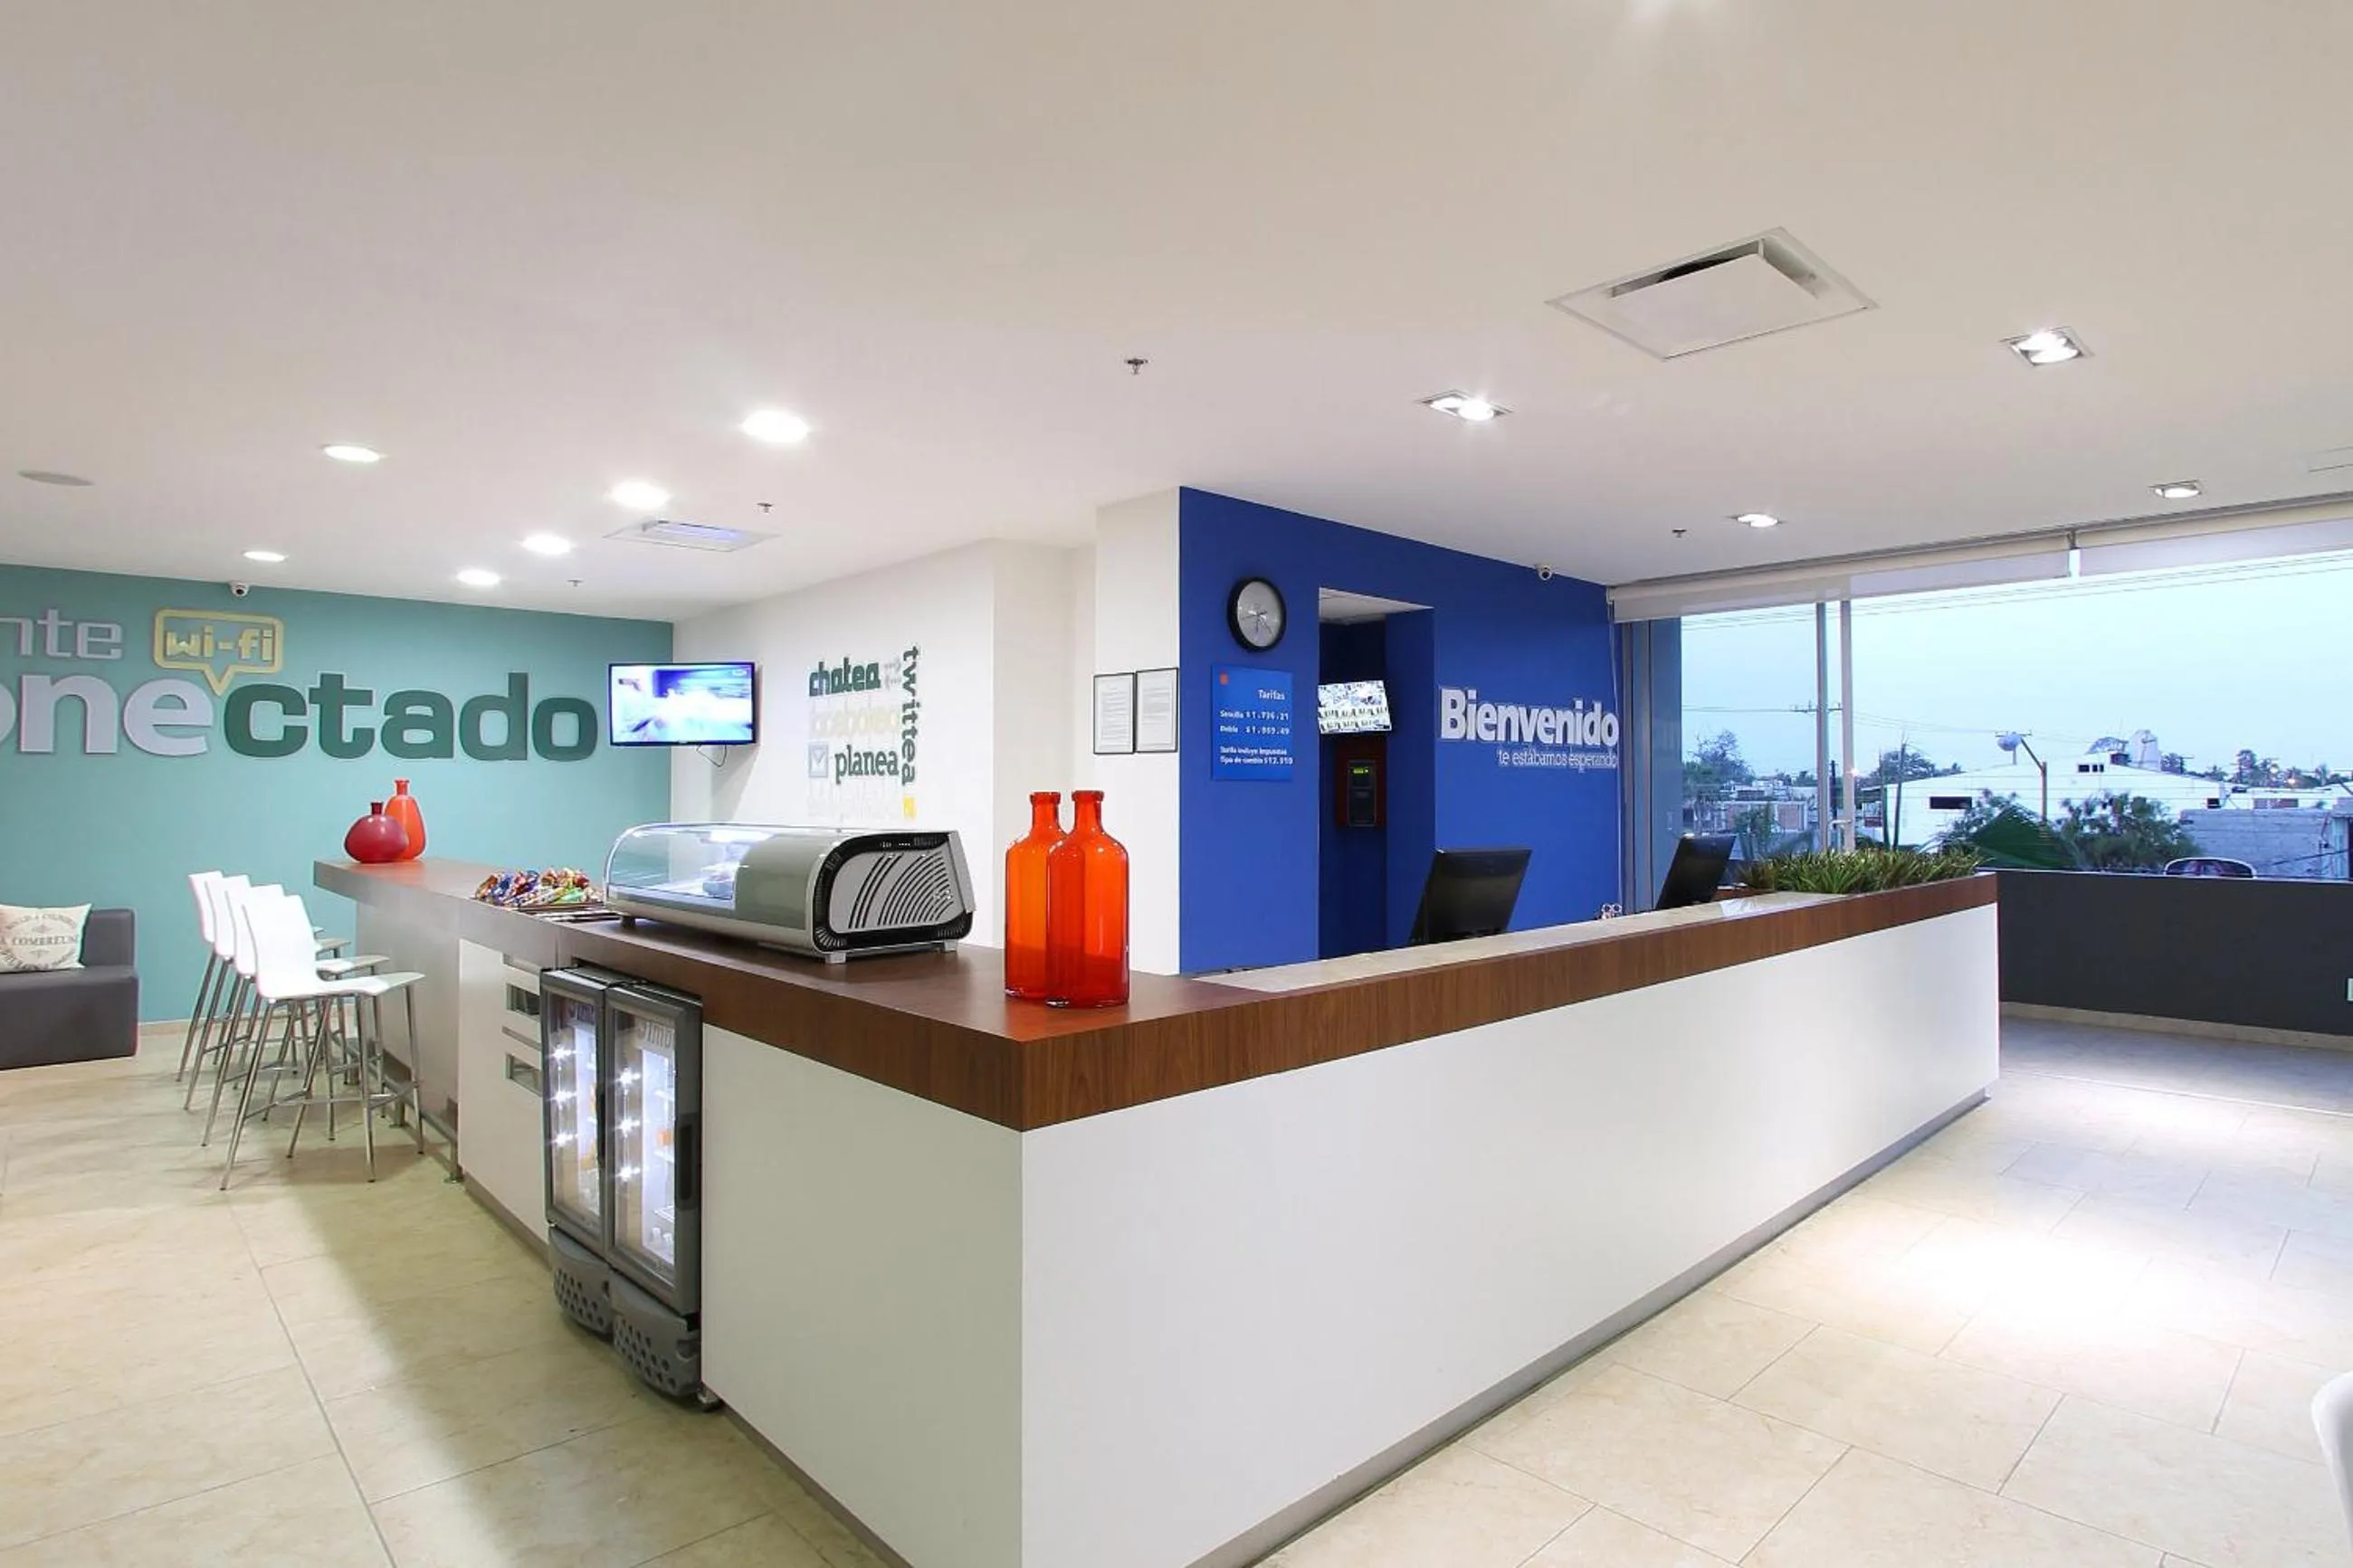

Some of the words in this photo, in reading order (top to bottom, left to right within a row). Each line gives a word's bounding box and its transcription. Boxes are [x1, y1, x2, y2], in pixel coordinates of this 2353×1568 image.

[165, 625, 274, 661] wi-fi
[809, 657, 881, 697] chatea
[1258, 689, 1286, 701] Tarifas
[0, 672, 599, 761] nectado
[901, 646, 921, 786] twittea
[1440, 688, 1620, 747] Bienvenido
[834, 744, 900, 785] planea
[1499, 749, 1510, 766] te
[1568, 749, 1617, 774] esperando
